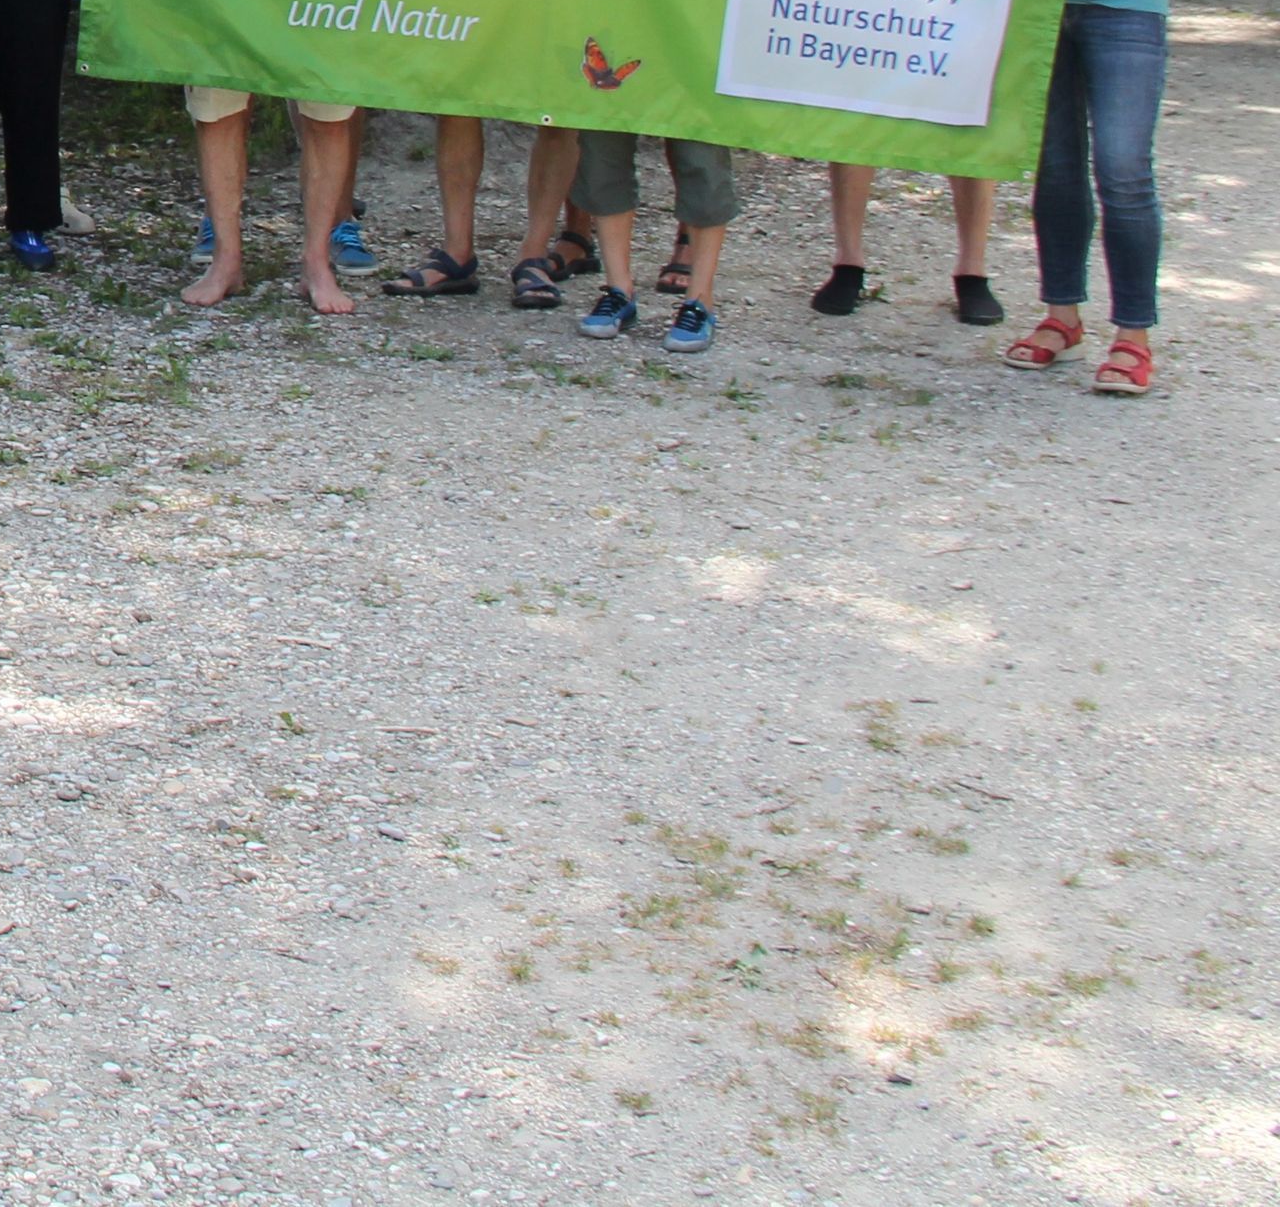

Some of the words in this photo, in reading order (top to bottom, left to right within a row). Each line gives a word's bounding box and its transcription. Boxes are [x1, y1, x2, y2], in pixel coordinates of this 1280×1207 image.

[370, 0, 480, 42] Natur
[766, 28, 792, 55] in
[799, 32, 898, 71] Bayern
[905, 49, 948, 78] e.V.
